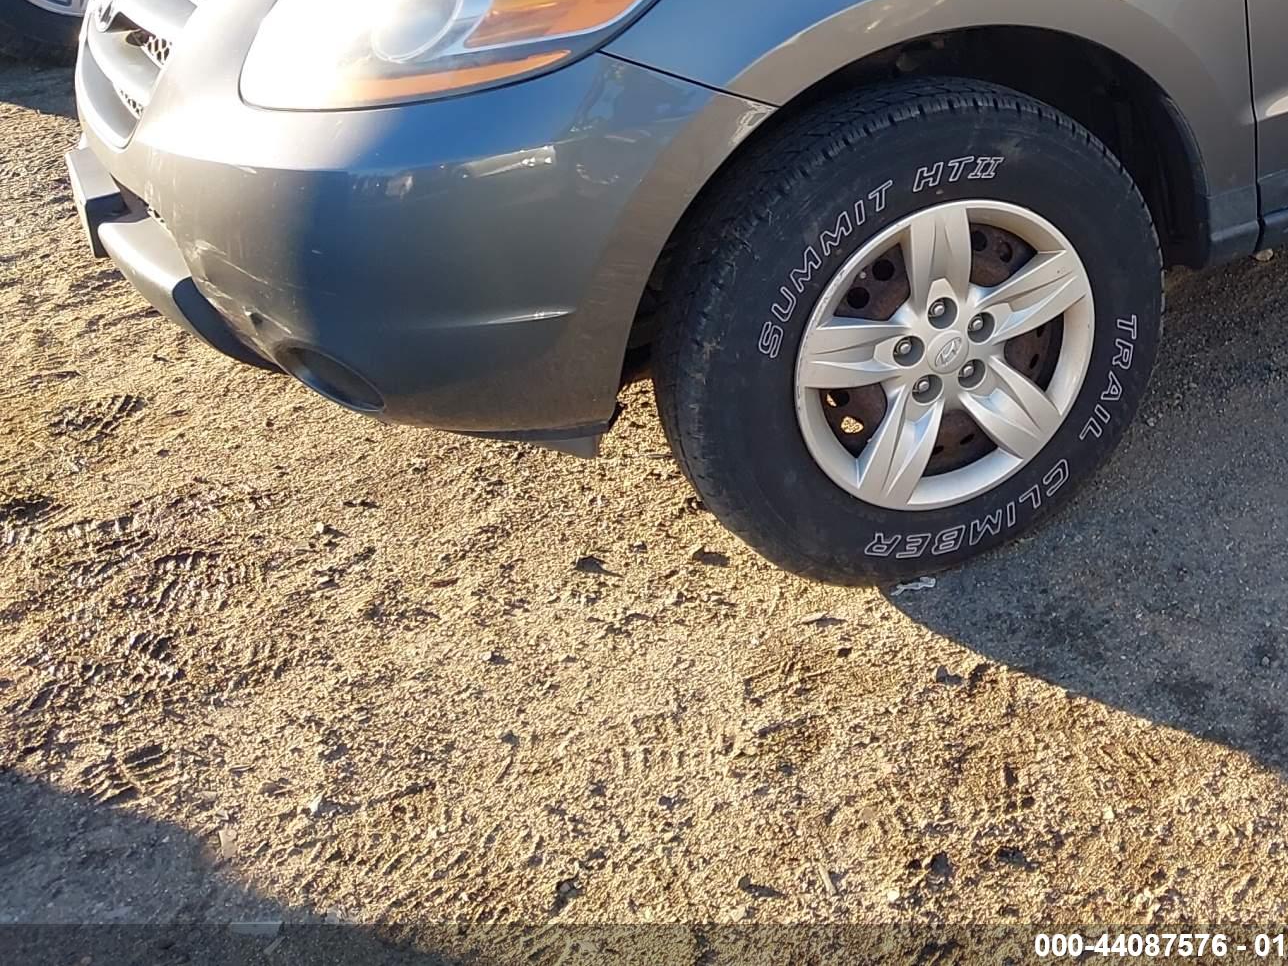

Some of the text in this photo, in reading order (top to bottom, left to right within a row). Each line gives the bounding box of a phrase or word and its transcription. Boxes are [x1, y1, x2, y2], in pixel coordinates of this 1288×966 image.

[759, 180, 893, 358] SUMMIT
[865, 314, 1137, 558] TRAIL CLIMBER
